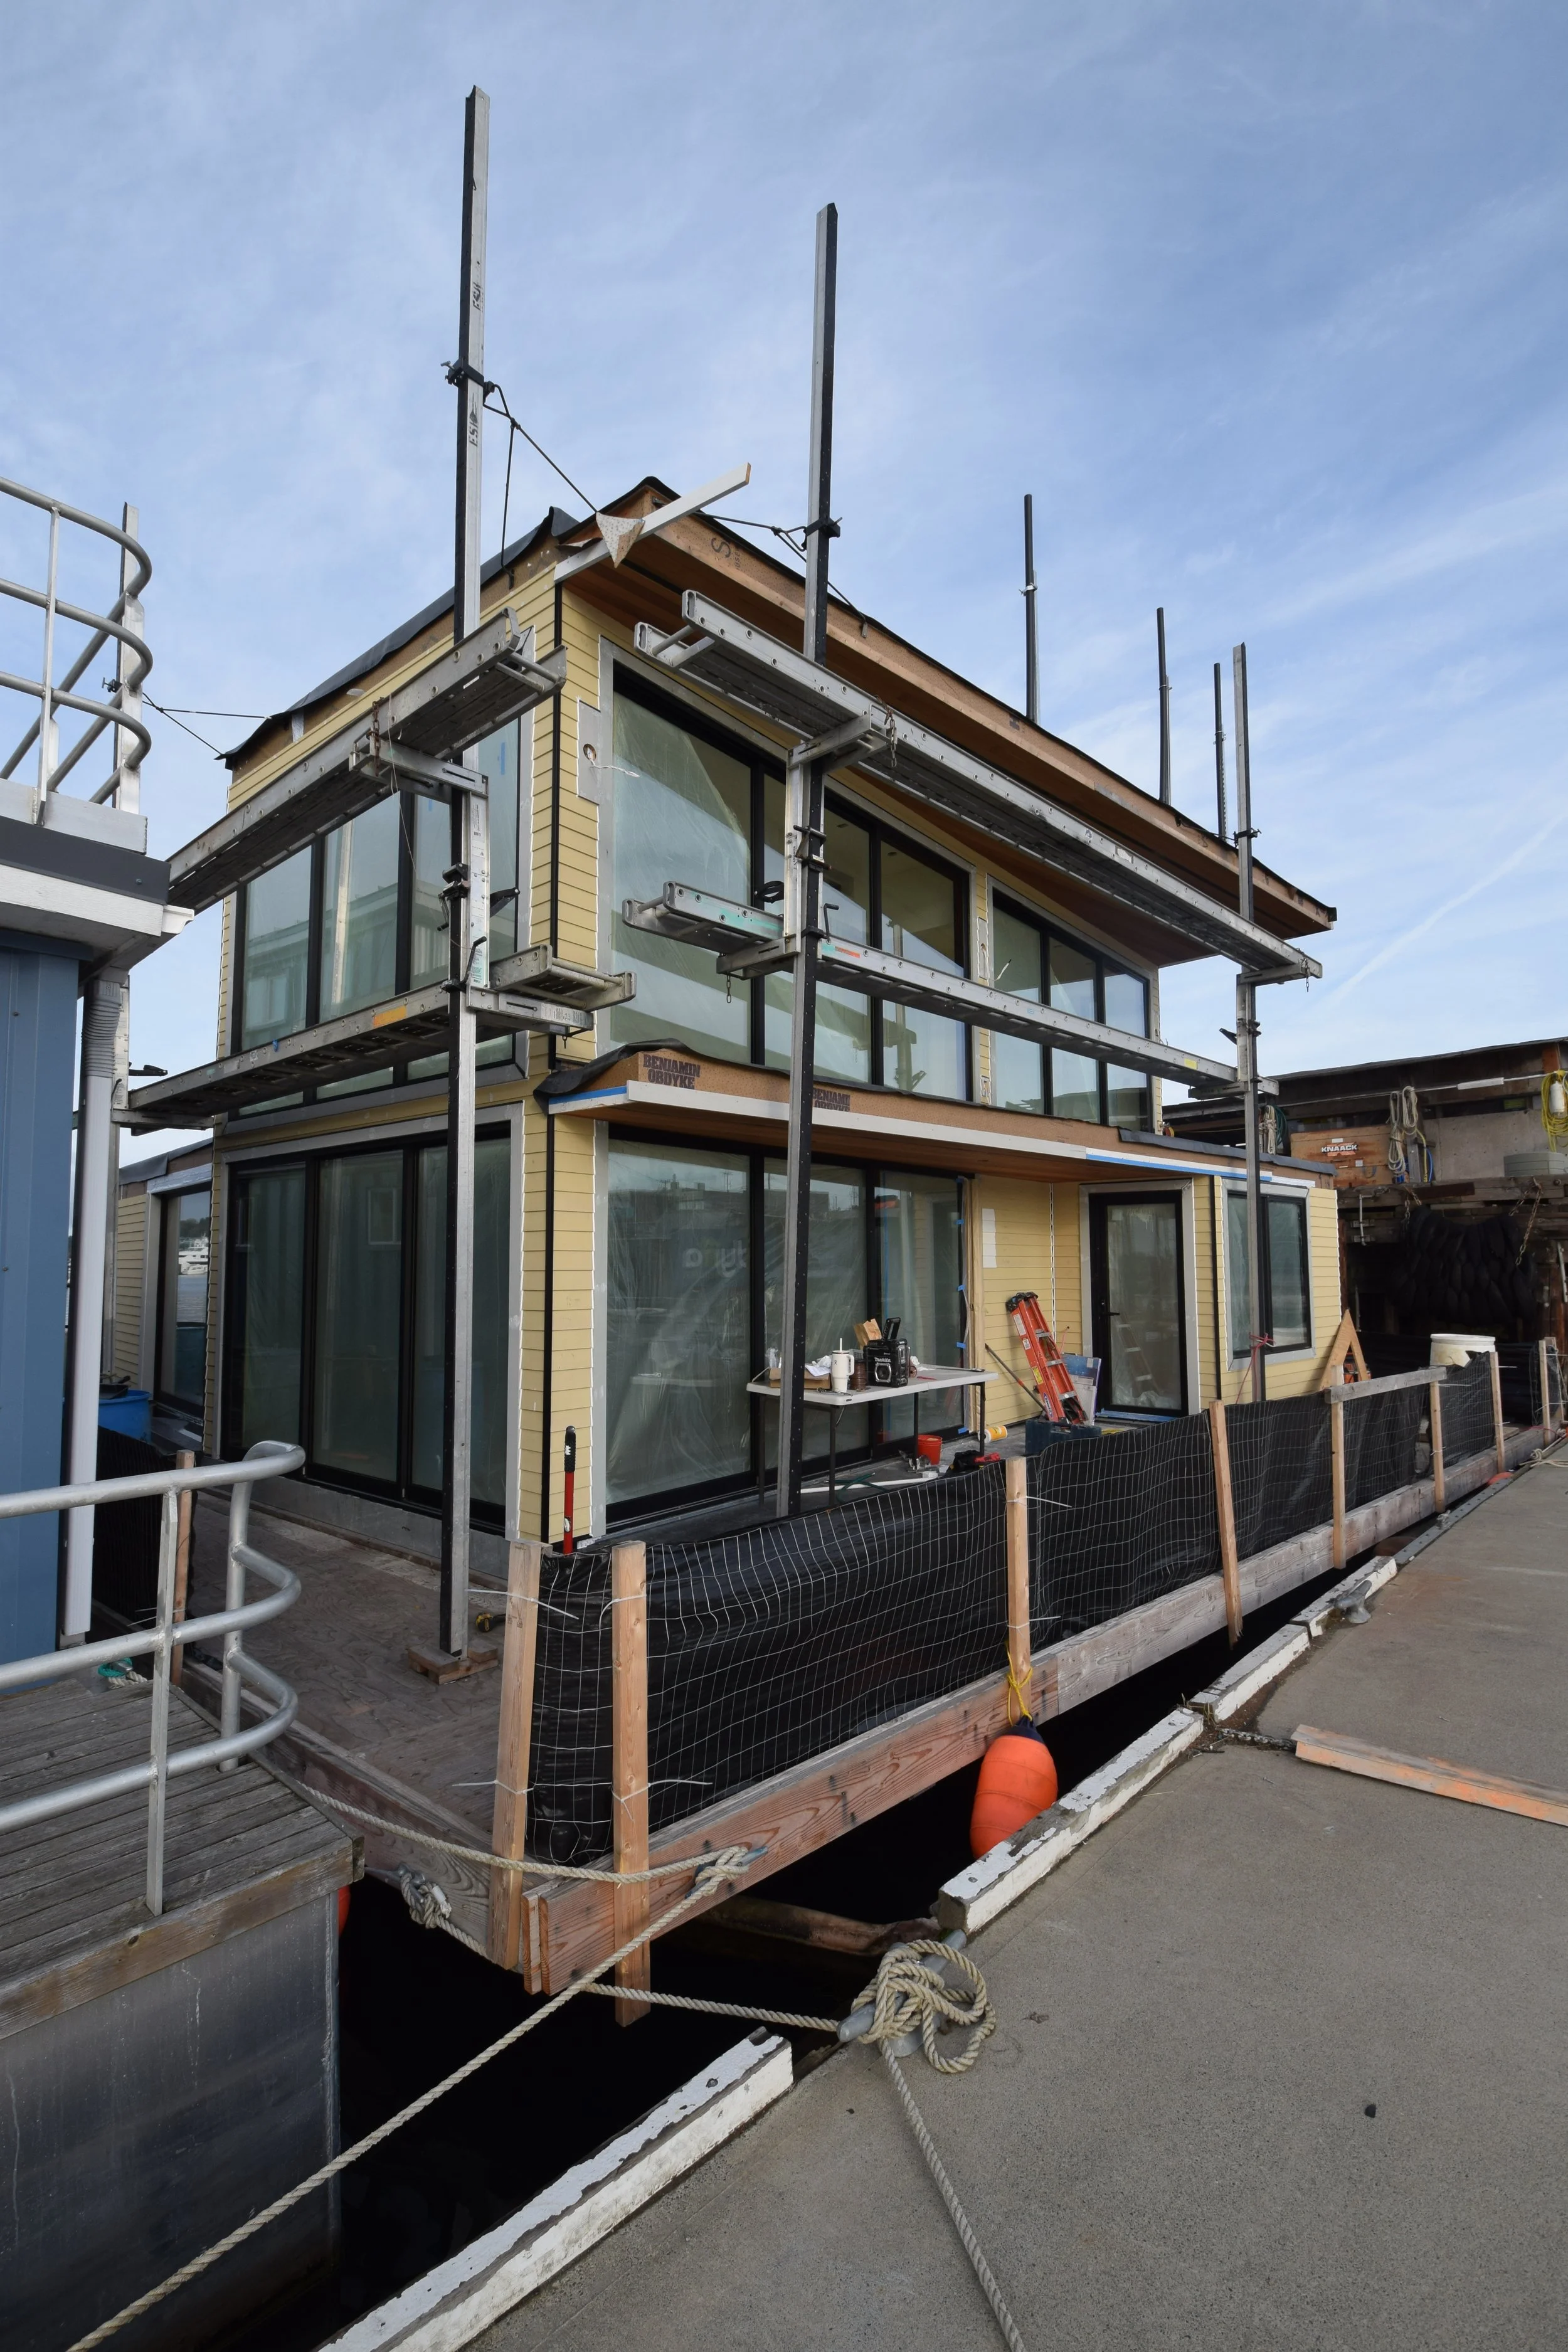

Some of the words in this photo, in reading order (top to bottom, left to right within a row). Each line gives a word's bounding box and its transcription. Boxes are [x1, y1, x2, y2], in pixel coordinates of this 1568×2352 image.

[644, 1054, 701, 1078] BENJAMIN
[648, 1069, 695, 1089] OBDYKE
[813, 1089, 850, 1106] BENJAMI
[1321, 1145, 1358, 1153] KNAACK
